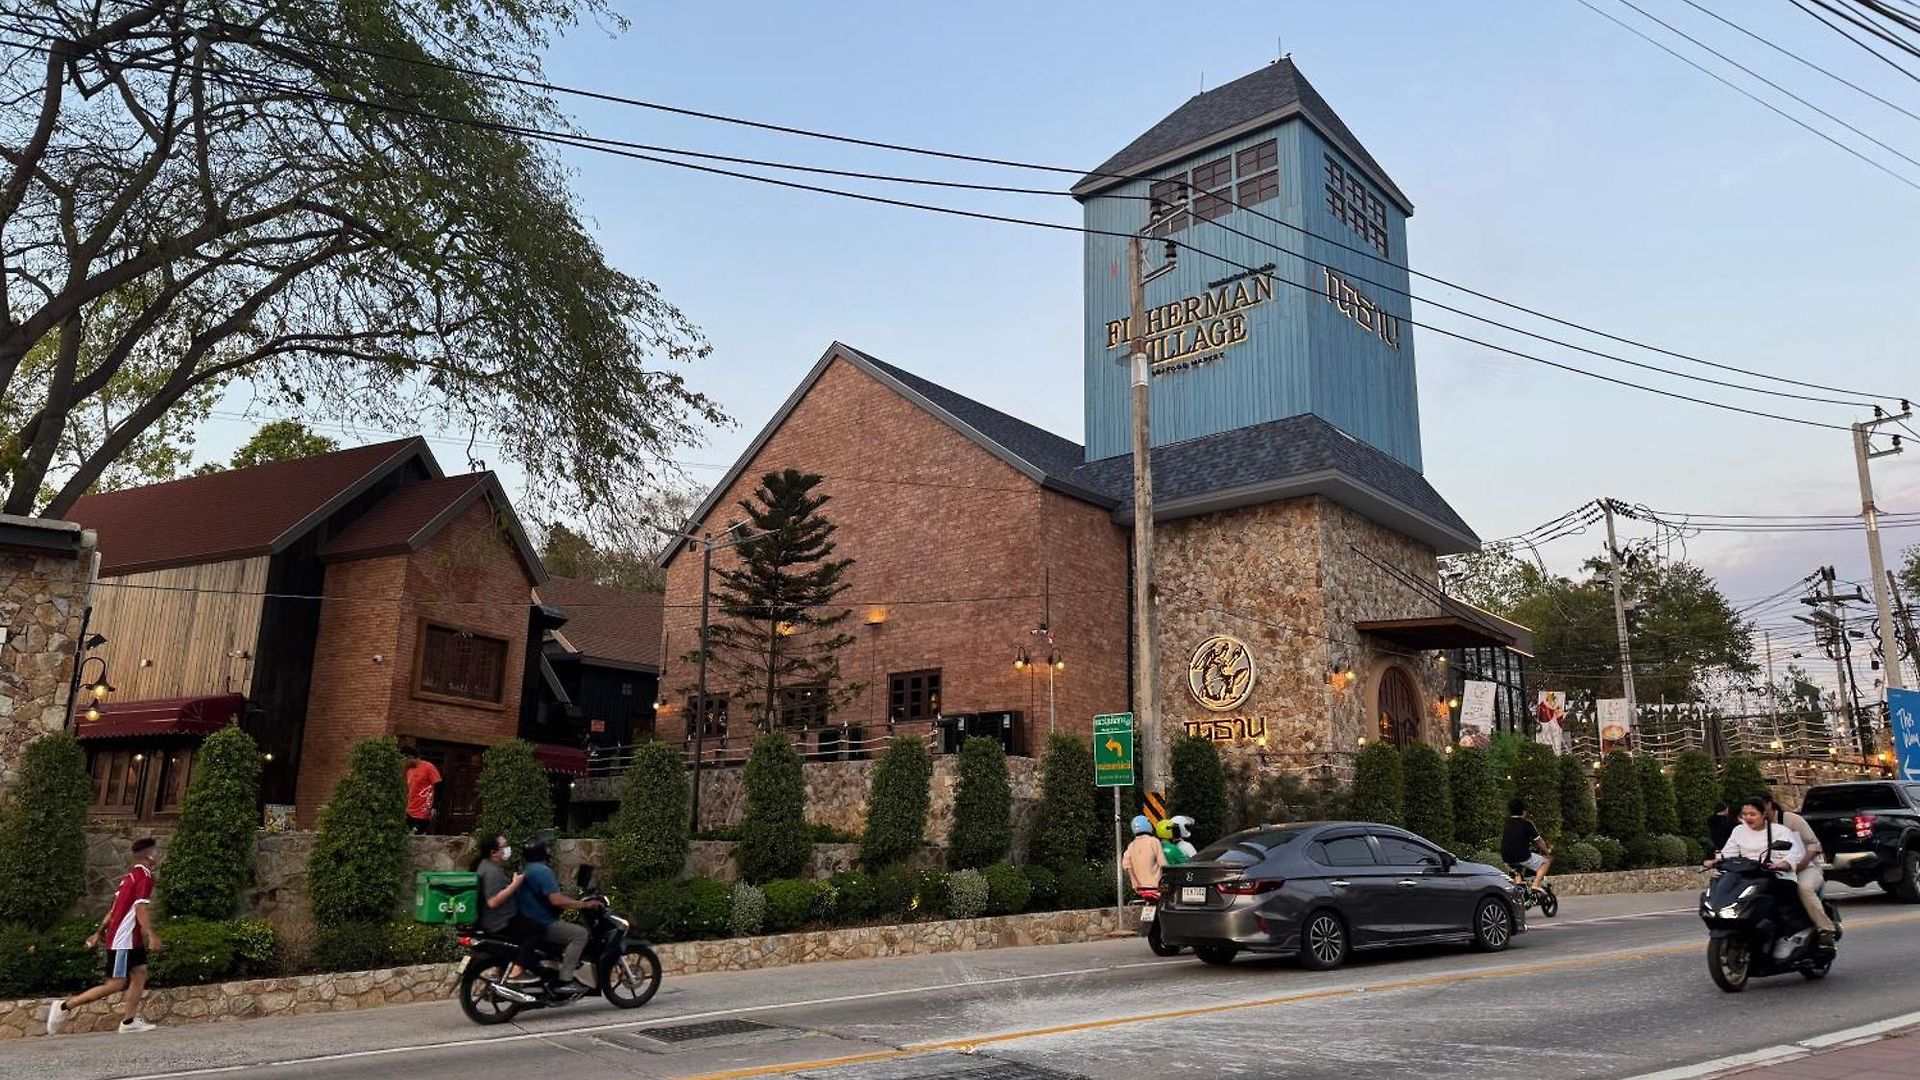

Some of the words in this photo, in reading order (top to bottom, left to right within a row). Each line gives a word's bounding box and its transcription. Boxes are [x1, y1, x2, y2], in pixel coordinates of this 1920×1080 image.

[1106, 272, 1276, 350] FIHERMAN
[1144, 314, 1249, 366] ILLAGE
[438, 902, 466, 912] Gb
